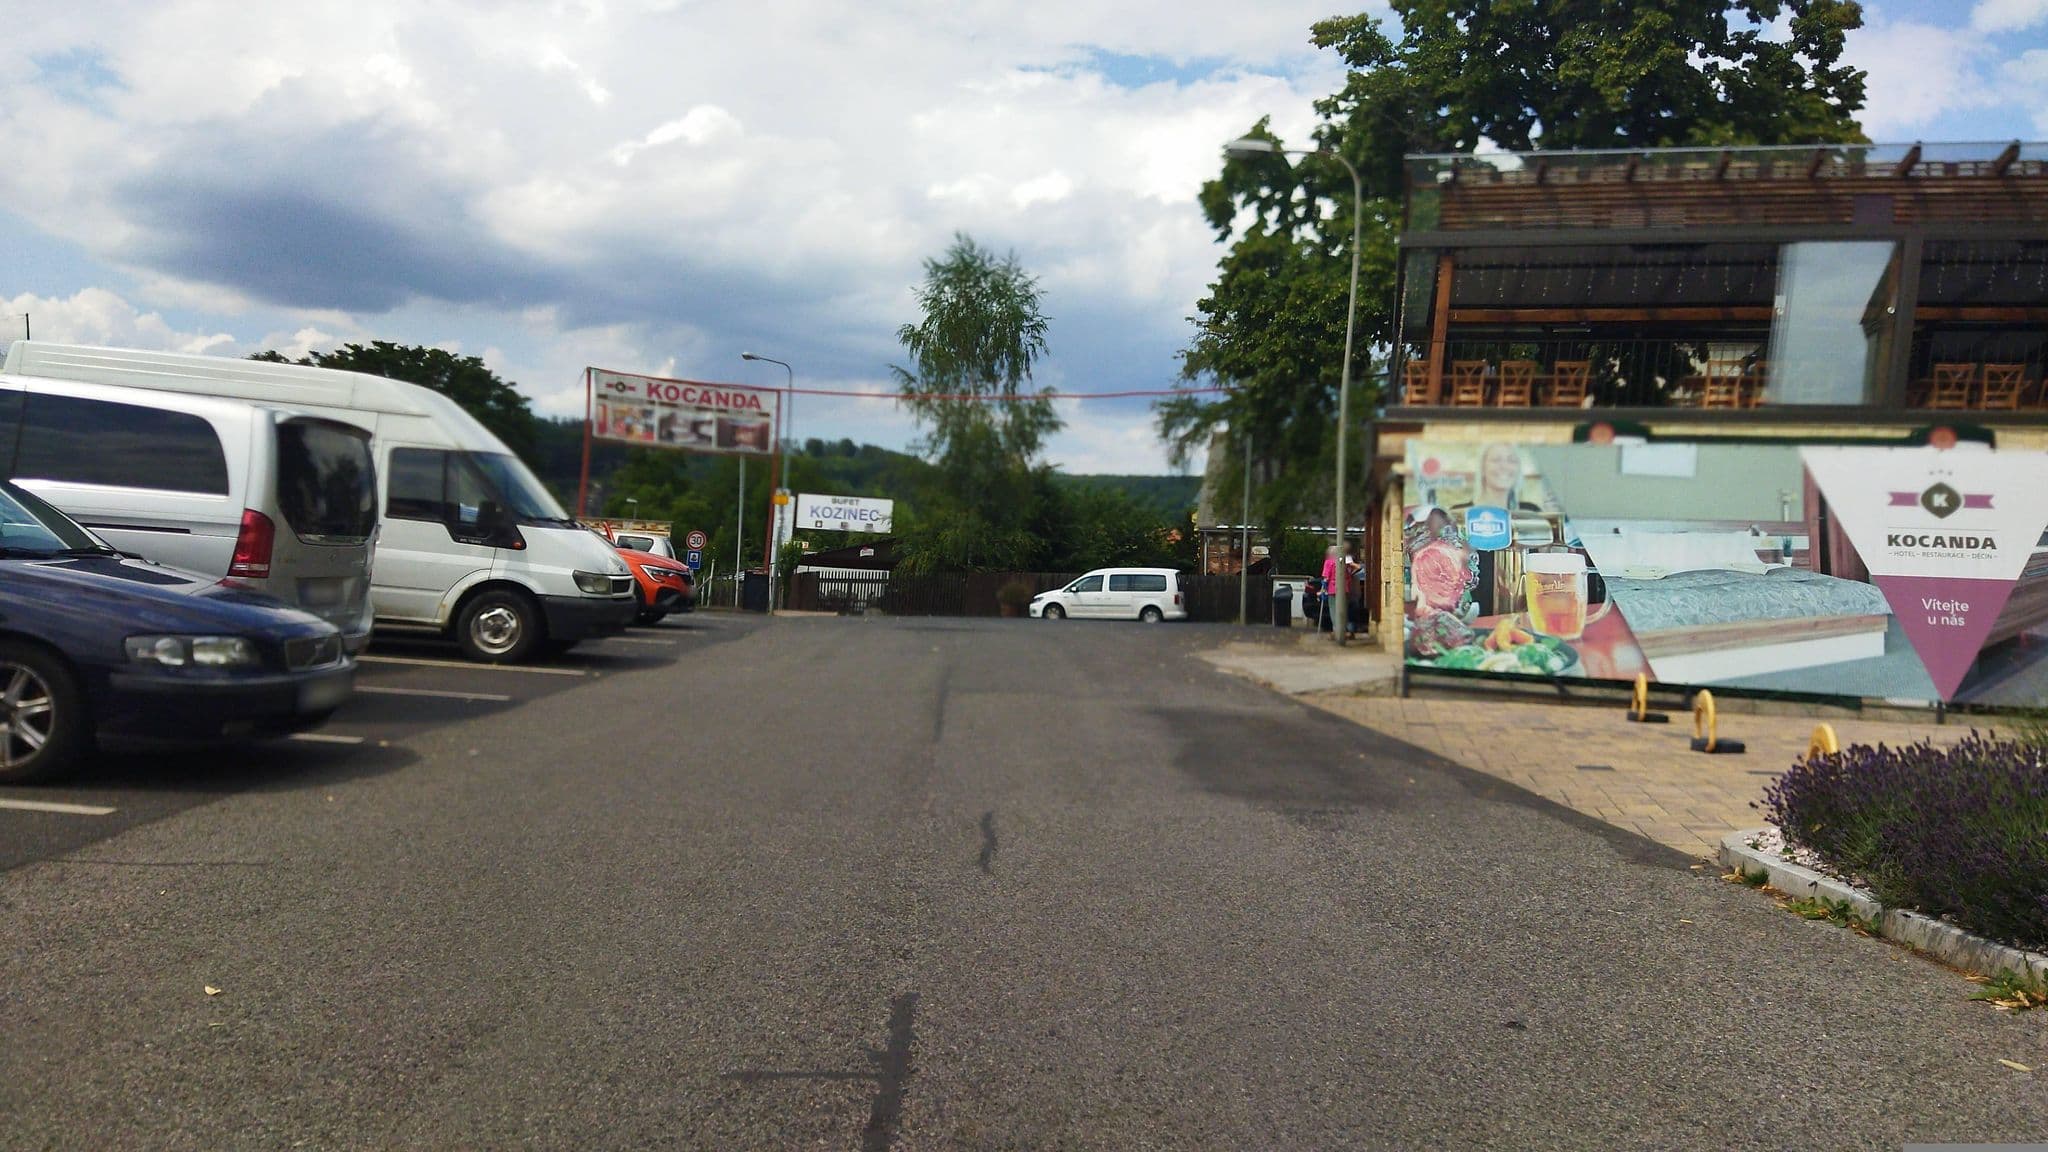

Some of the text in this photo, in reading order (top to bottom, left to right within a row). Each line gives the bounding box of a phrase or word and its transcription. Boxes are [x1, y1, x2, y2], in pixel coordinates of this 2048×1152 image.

[646, 382, 762, 410] KOCANDA
[1932, 493, 1949, 507] K
[809, 505, 880, 522] KOZINEC
[691, 536, 702, 545] 30
[1887, 534, 1997, 550] KOCANDA
[1922, 551, 1964, 559] RESTAURACE
[1922, 598, 1970, 614] Vítejte
[1928, 614, 1966, 626] u nás
